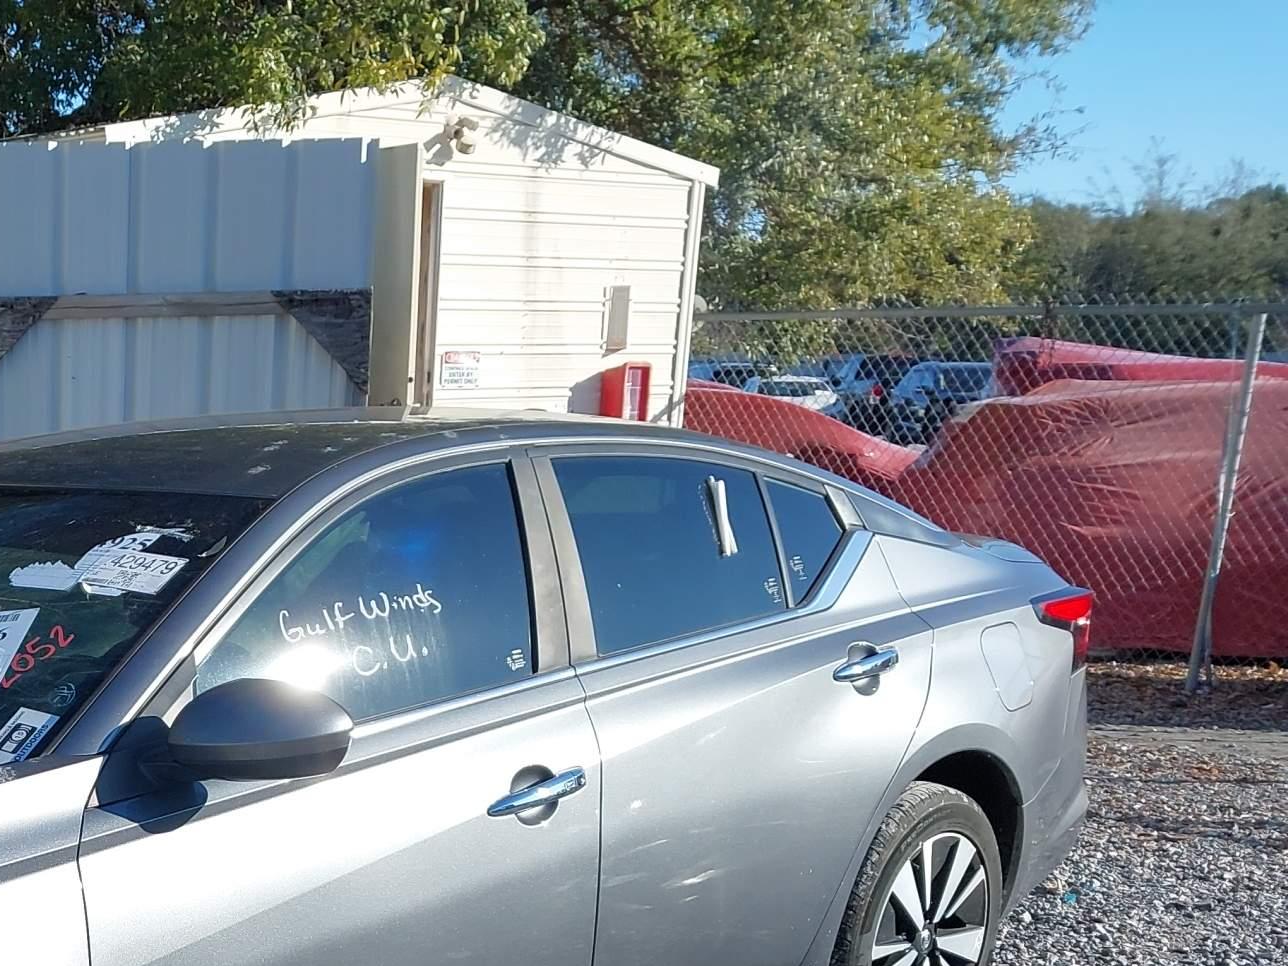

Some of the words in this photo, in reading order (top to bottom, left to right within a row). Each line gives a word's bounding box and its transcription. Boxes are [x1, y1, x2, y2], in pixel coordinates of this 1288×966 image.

[111, 555, 178, 575] 429479
[279, 602, 355, 643] Gulf
[359, 583, 443, 619] Winds
